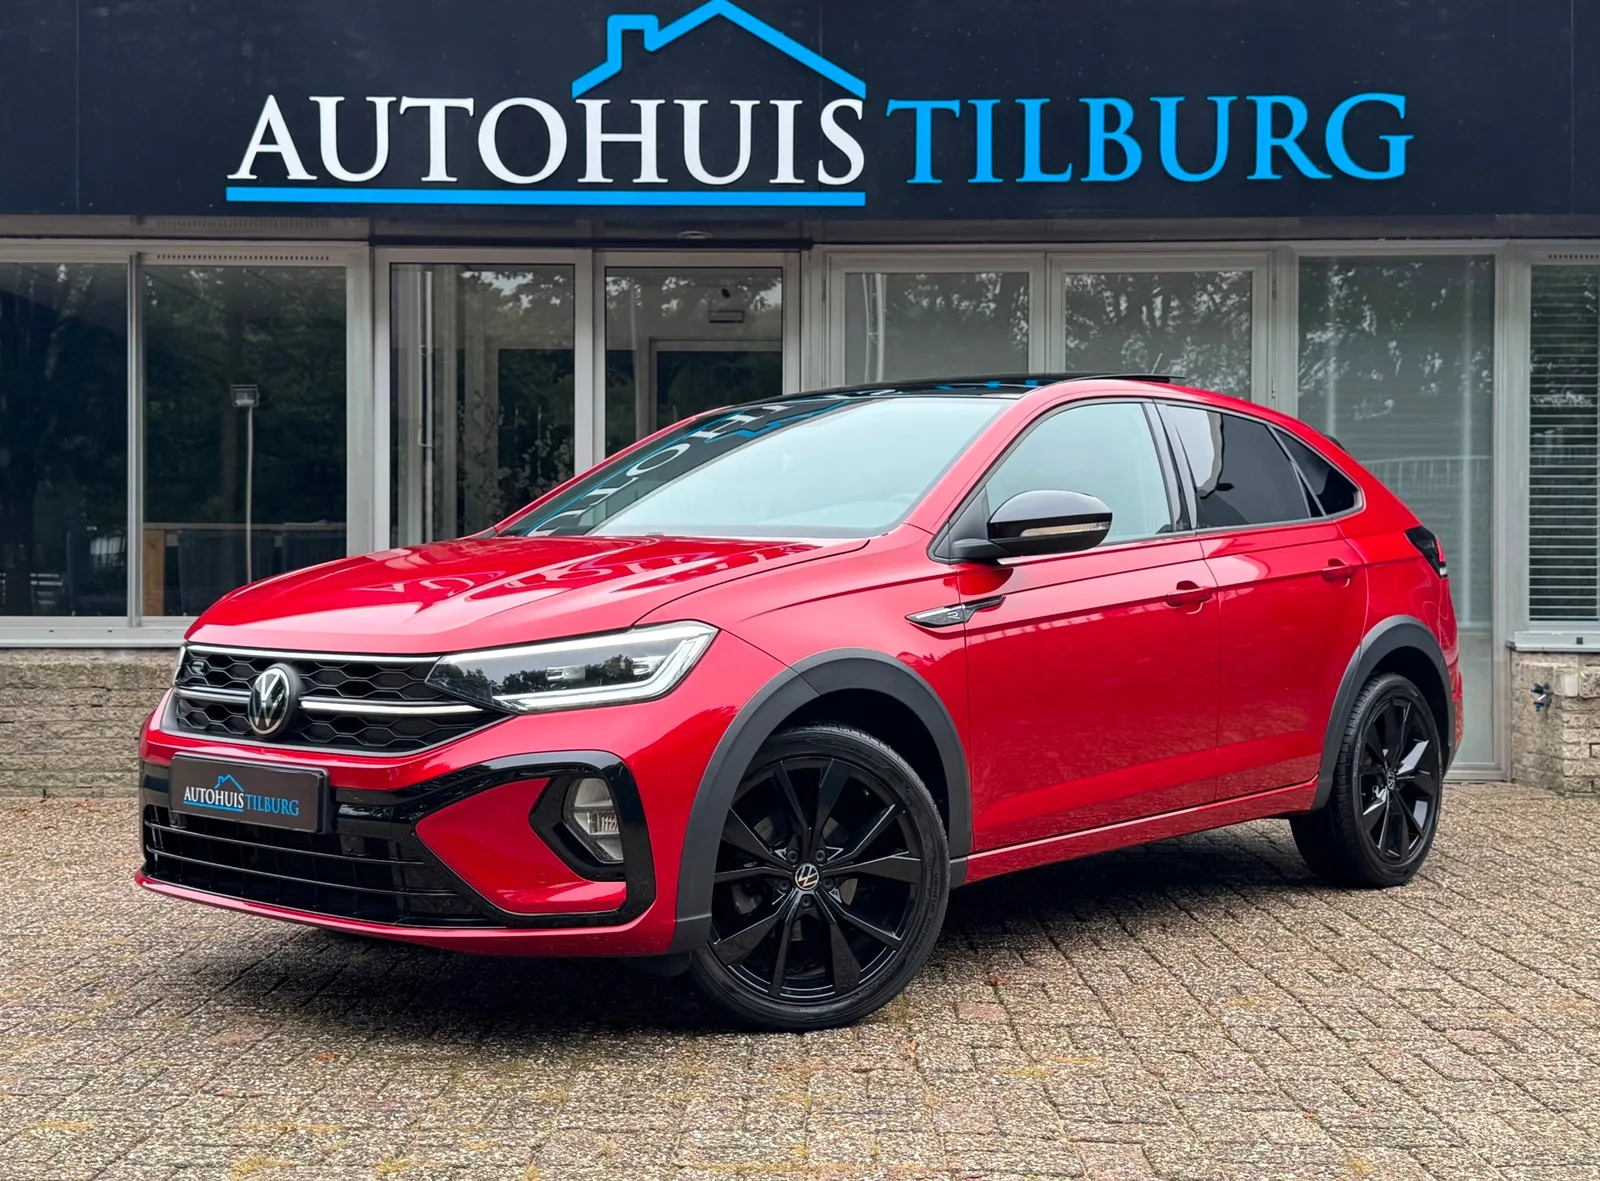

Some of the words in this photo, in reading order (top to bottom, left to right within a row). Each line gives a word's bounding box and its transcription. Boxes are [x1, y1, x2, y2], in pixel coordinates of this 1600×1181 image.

[227, 94, 865, 186] AUTOHUIS
[886, 93, 1414, 184] TILBURG
[183, 785, 244, 808] AUTOHUIS
[245, 793, 299, 816] TILBURG
